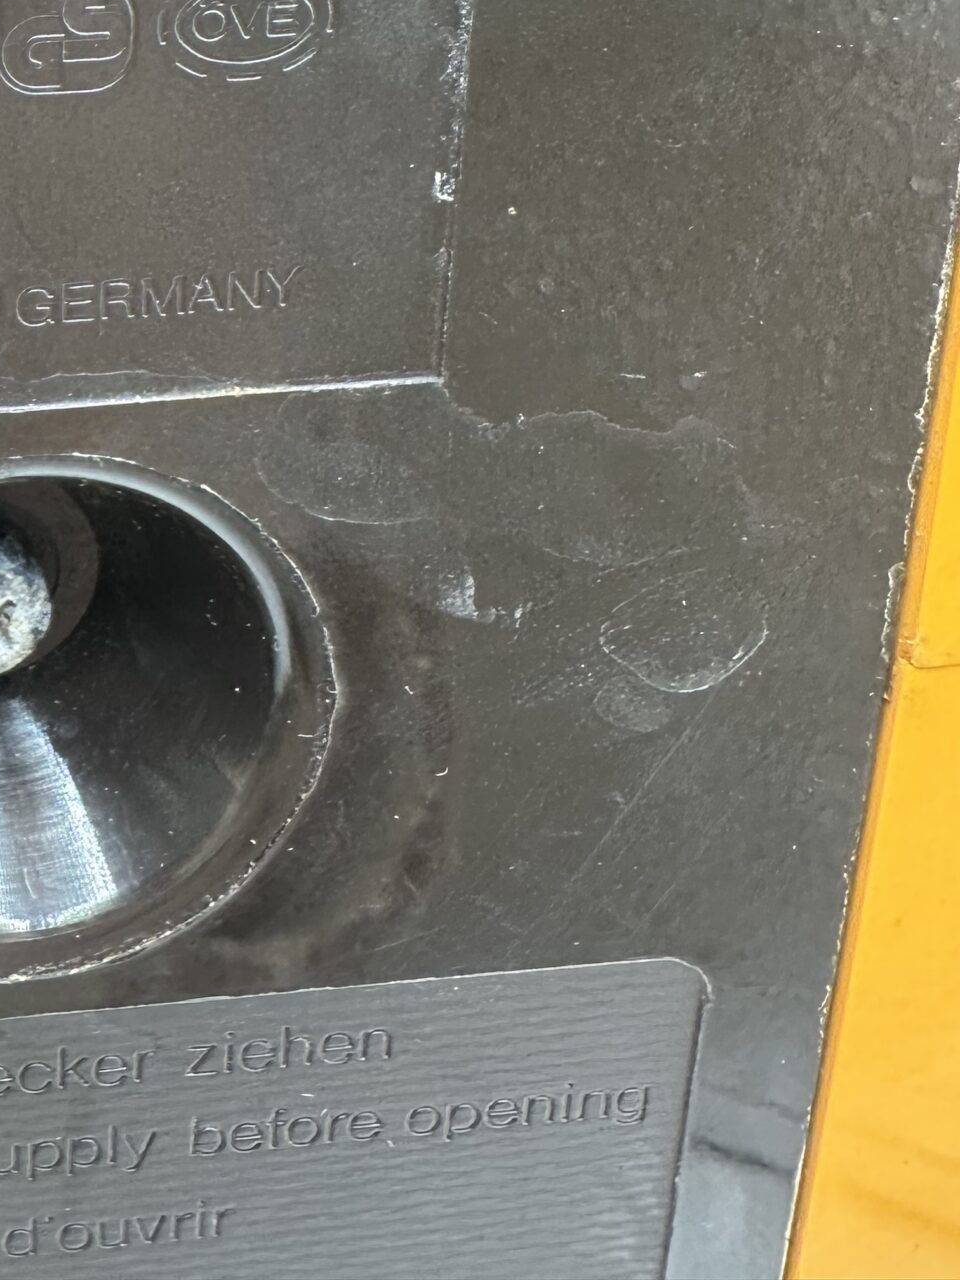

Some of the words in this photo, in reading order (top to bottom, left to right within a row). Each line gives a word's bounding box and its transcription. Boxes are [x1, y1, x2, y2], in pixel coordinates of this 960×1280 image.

[14, 265, 304, 328] GERMANY
[184, 1025, 394, 1078] ziehen
[190, 1107, 384, 1157] before
[403, 1081, 654, 1142] opening
